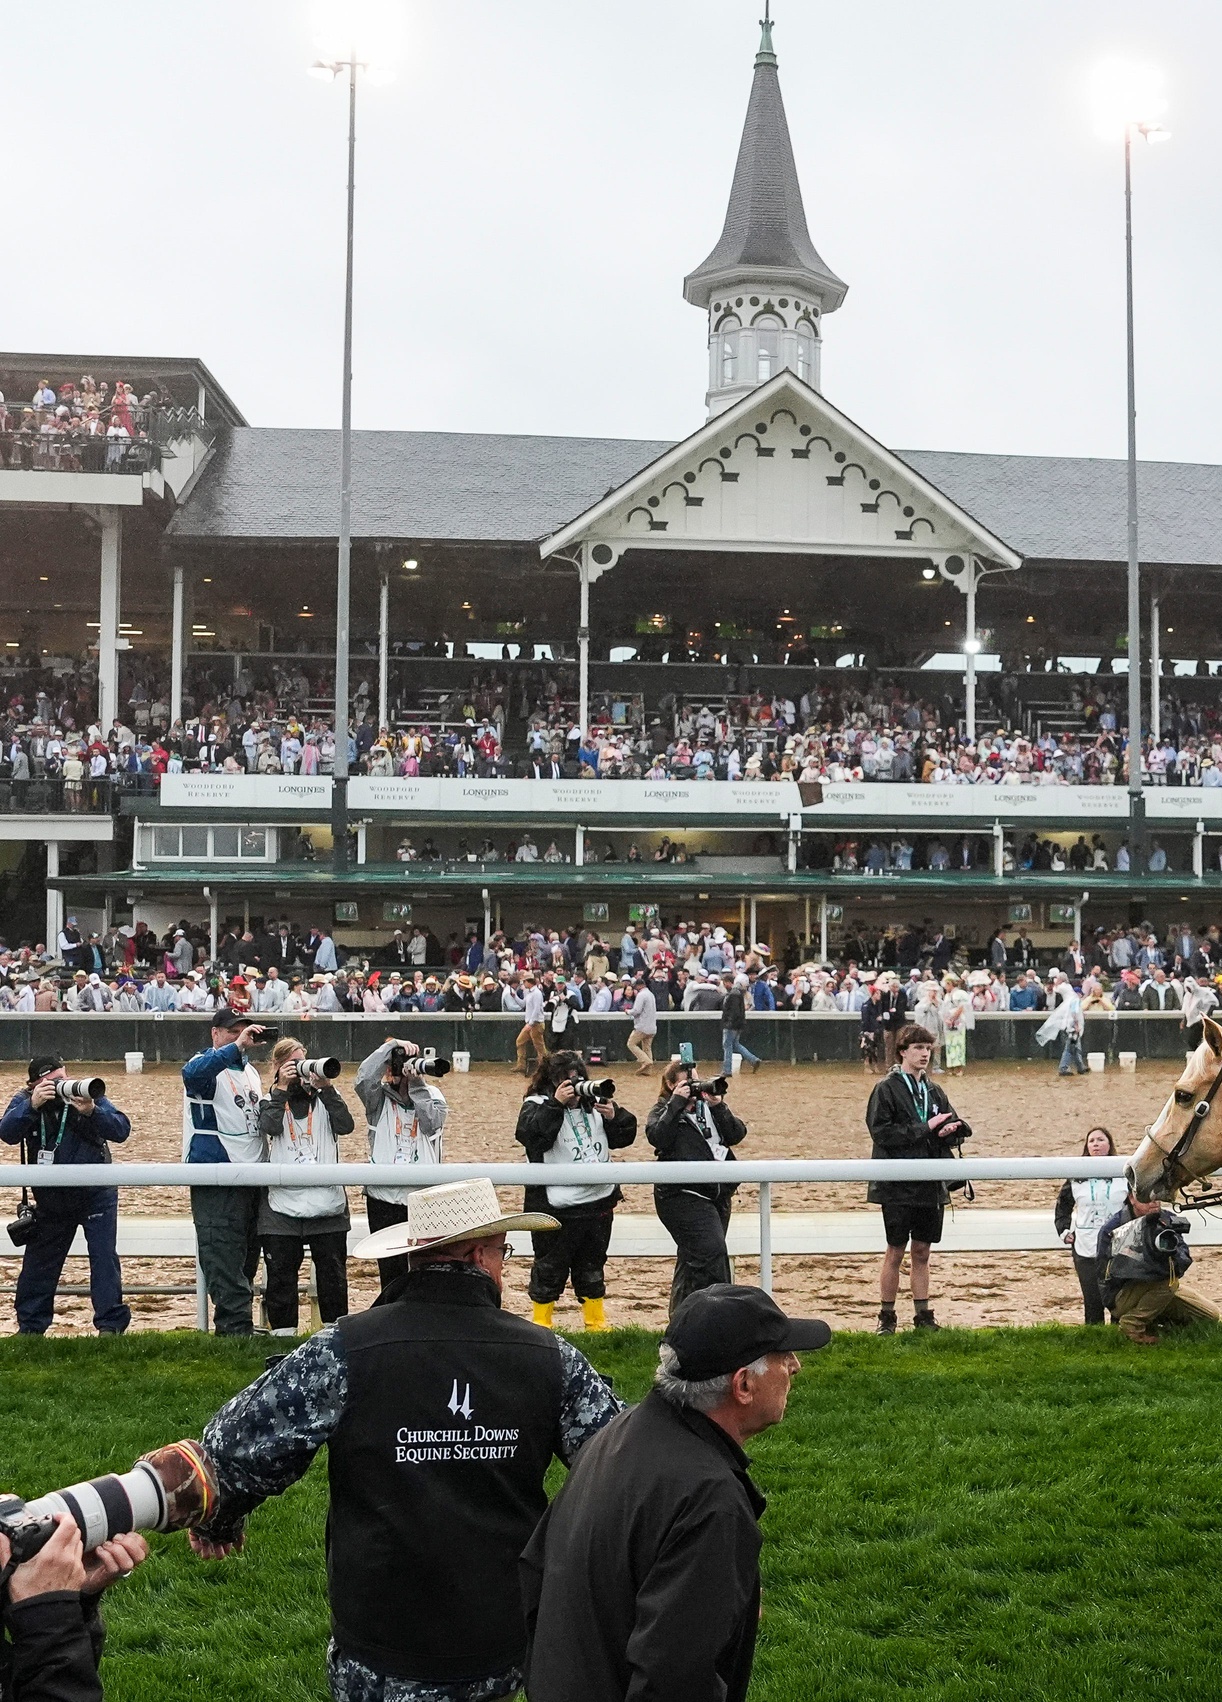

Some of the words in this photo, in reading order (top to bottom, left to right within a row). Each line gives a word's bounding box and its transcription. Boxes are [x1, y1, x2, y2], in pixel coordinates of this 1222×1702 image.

[182, 782, 235, 790] WOODFORD
[278, 785, 326, 794] LONGINES
[462, 788, 509, 796] LONGINES
[644, 790, 690, 798] LONGINES
[825, 792, 865, 800] ONGINES
[994, 794, 1037, 802] LONGINES
[1161, 796, 1202, 804] LONGINES
[571, 1141, 602, 1162] 29
[396, 1427, 471, 1443] CHURCHILL
[474, 1425, 519, 1442] DOWNS
[395, 1446, 451, 1464] EQUINE
[453, 1444, 518, 1460] SECURITY
